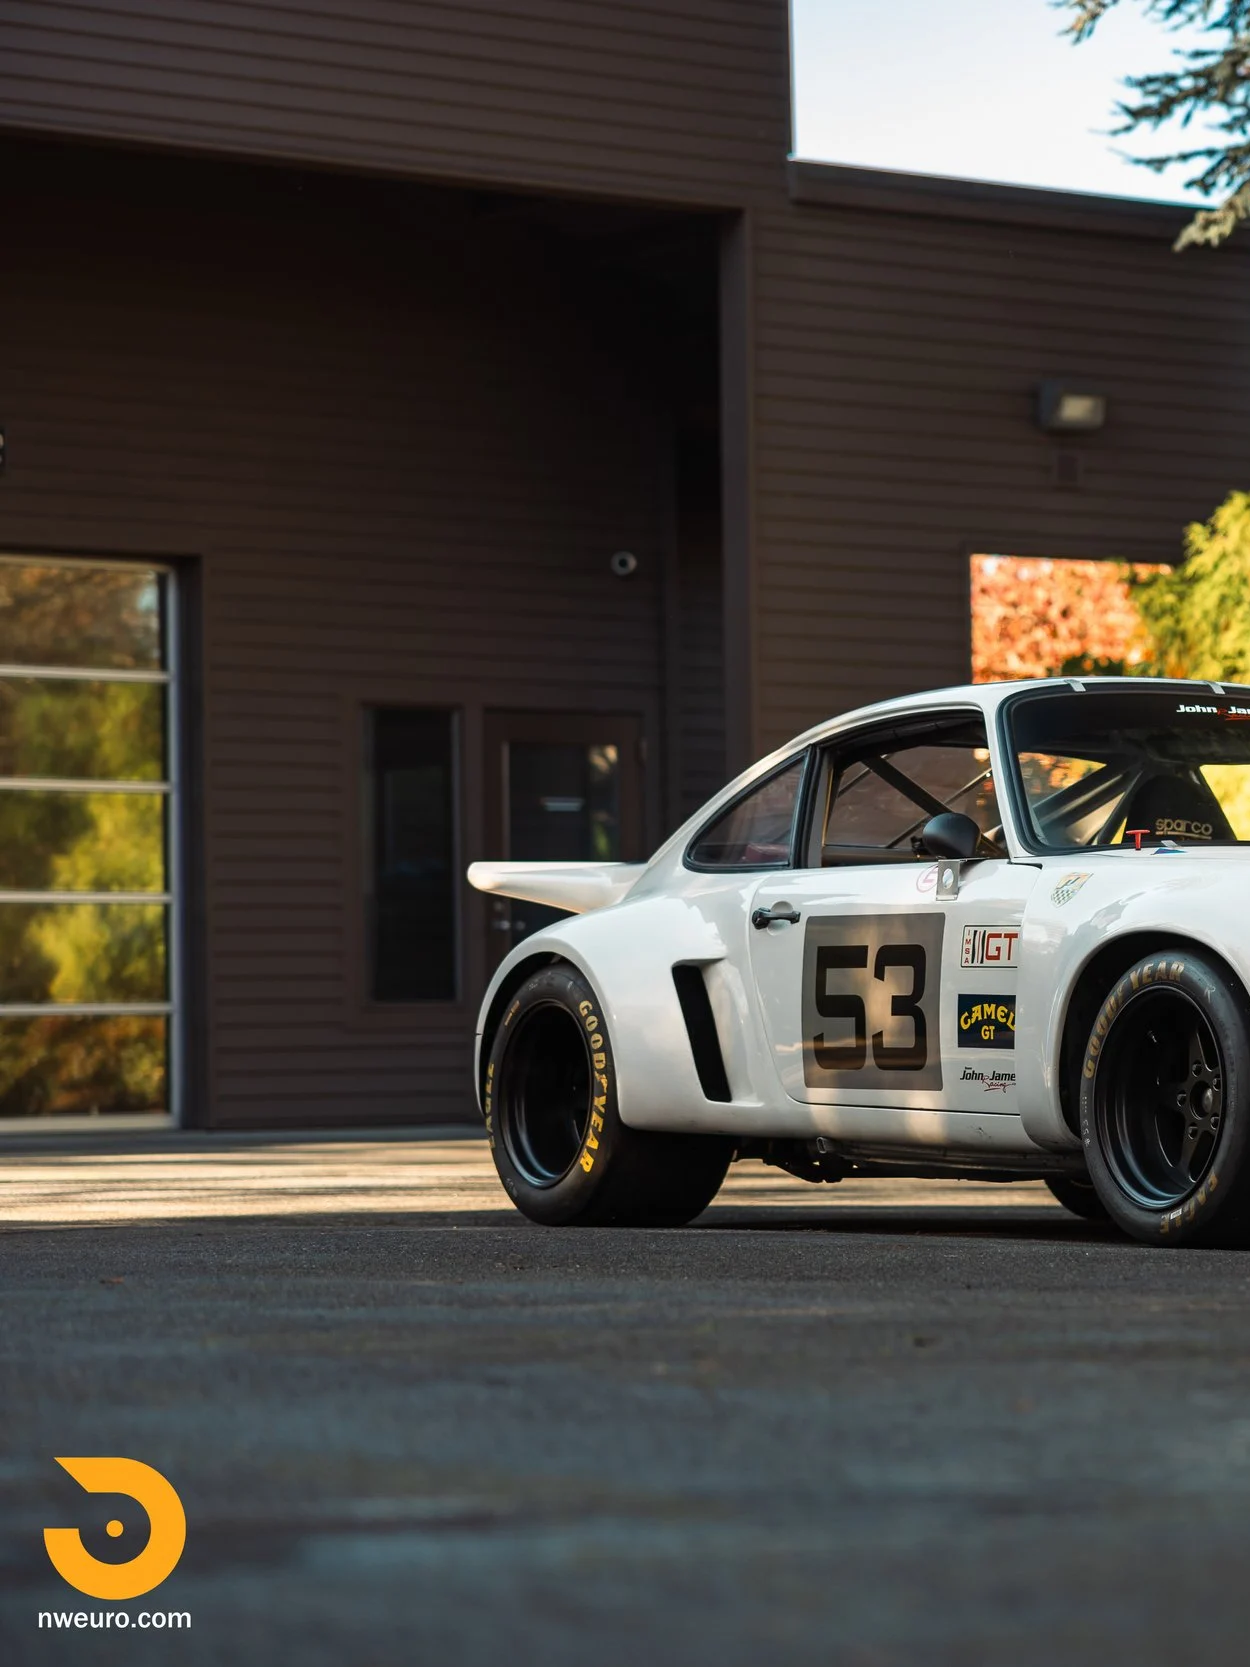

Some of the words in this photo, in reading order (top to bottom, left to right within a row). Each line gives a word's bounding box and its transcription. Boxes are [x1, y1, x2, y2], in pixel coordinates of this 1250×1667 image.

[1176, 704, 1218, 714] John
[1155, 818, 1213, 836] sparco
[963, 929, 971, 964] IMSA
[985, 932, 1018, 961] GT
[813, 943, 928, 1071] 53
[960, 1003, 1017, 1031] CAMEL
[981, 1025, 995, 1040] GT
[960, 1070, 984, 1081] John
[989, 1070, 1016, 1081] Jame
